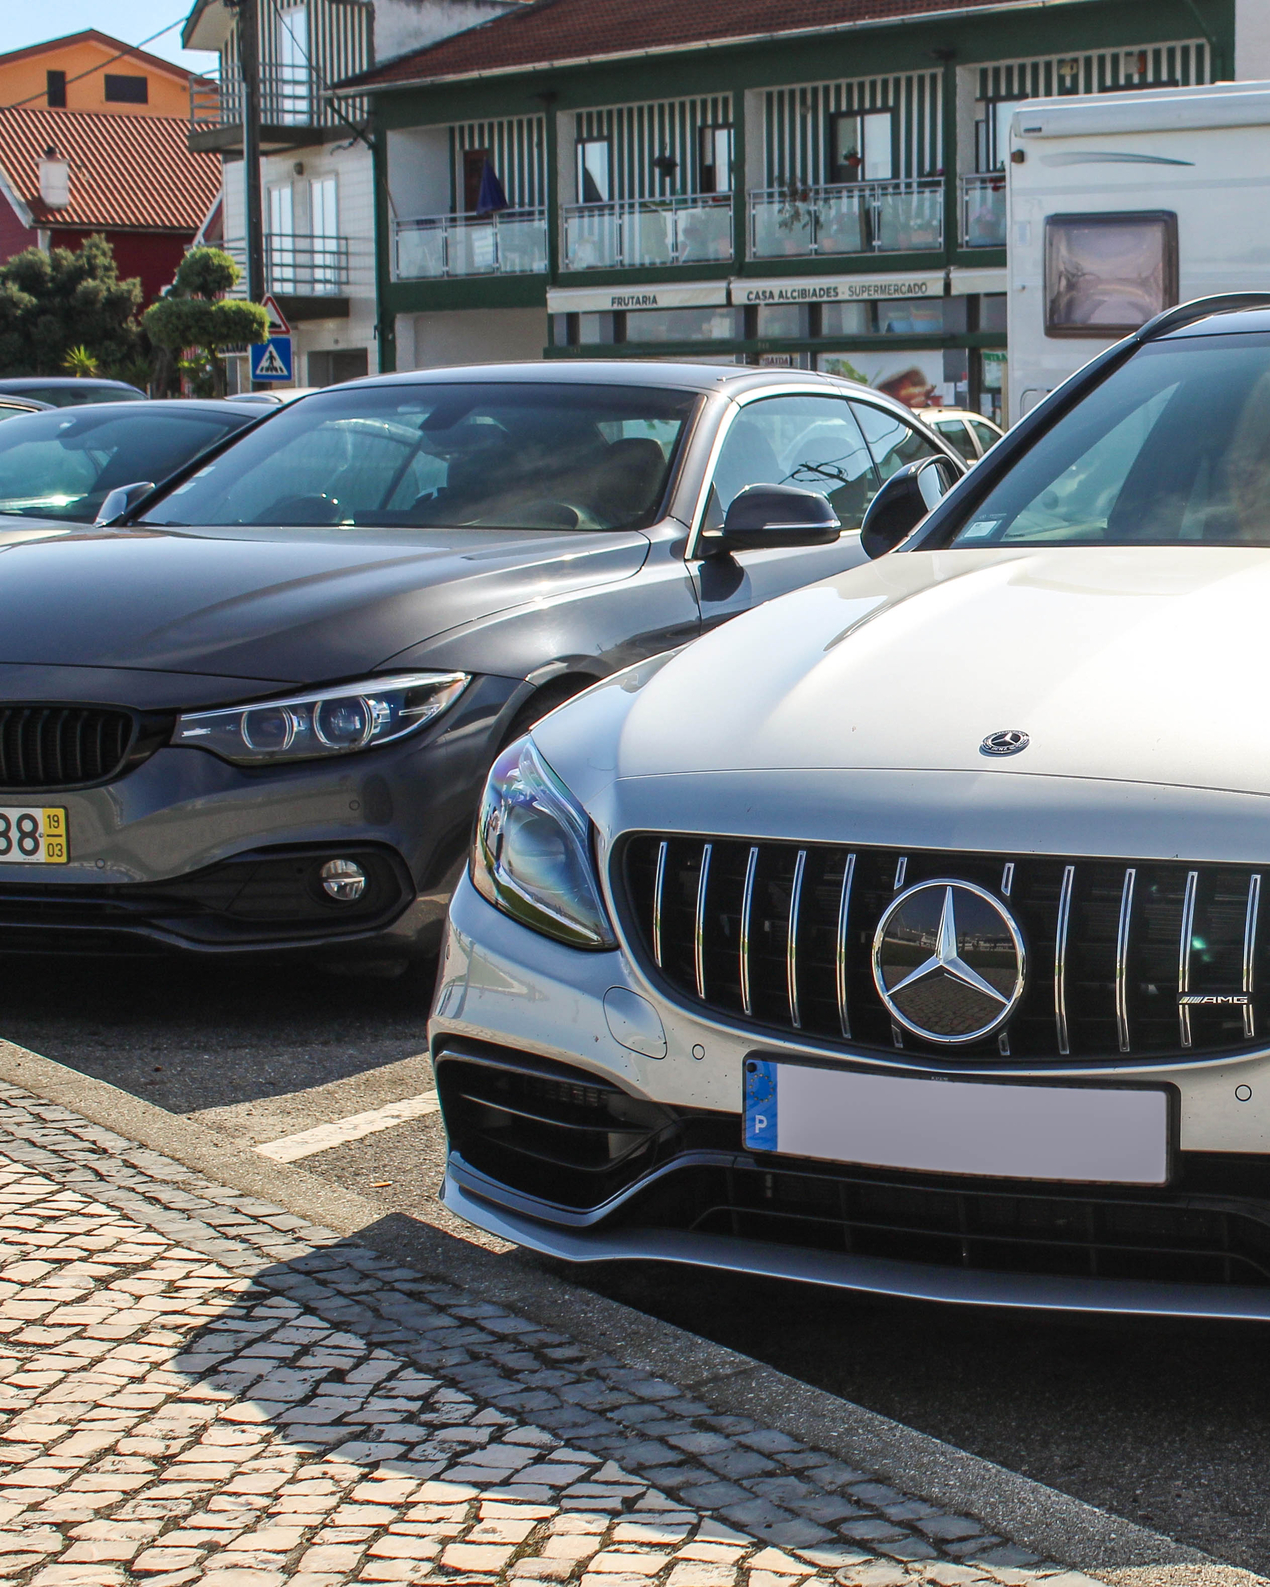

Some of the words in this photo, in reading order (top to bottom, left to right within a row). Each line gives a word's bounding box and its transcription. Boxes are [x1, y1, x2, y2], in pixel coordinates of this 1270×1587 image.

[747, 289, 775, 302] CASA
[777, 286, 839, 301] ALCIBIADES
[848, 282, 928, 298] SUPERMERCADO
[611, 294, 658, 307] FRUTARIA
[46, 814, 60, 829] 19
[47, 842, 63, 858] 03
[1201, 996, 1248, 1004] AMG
[755, 1114, 768, 1134] P
